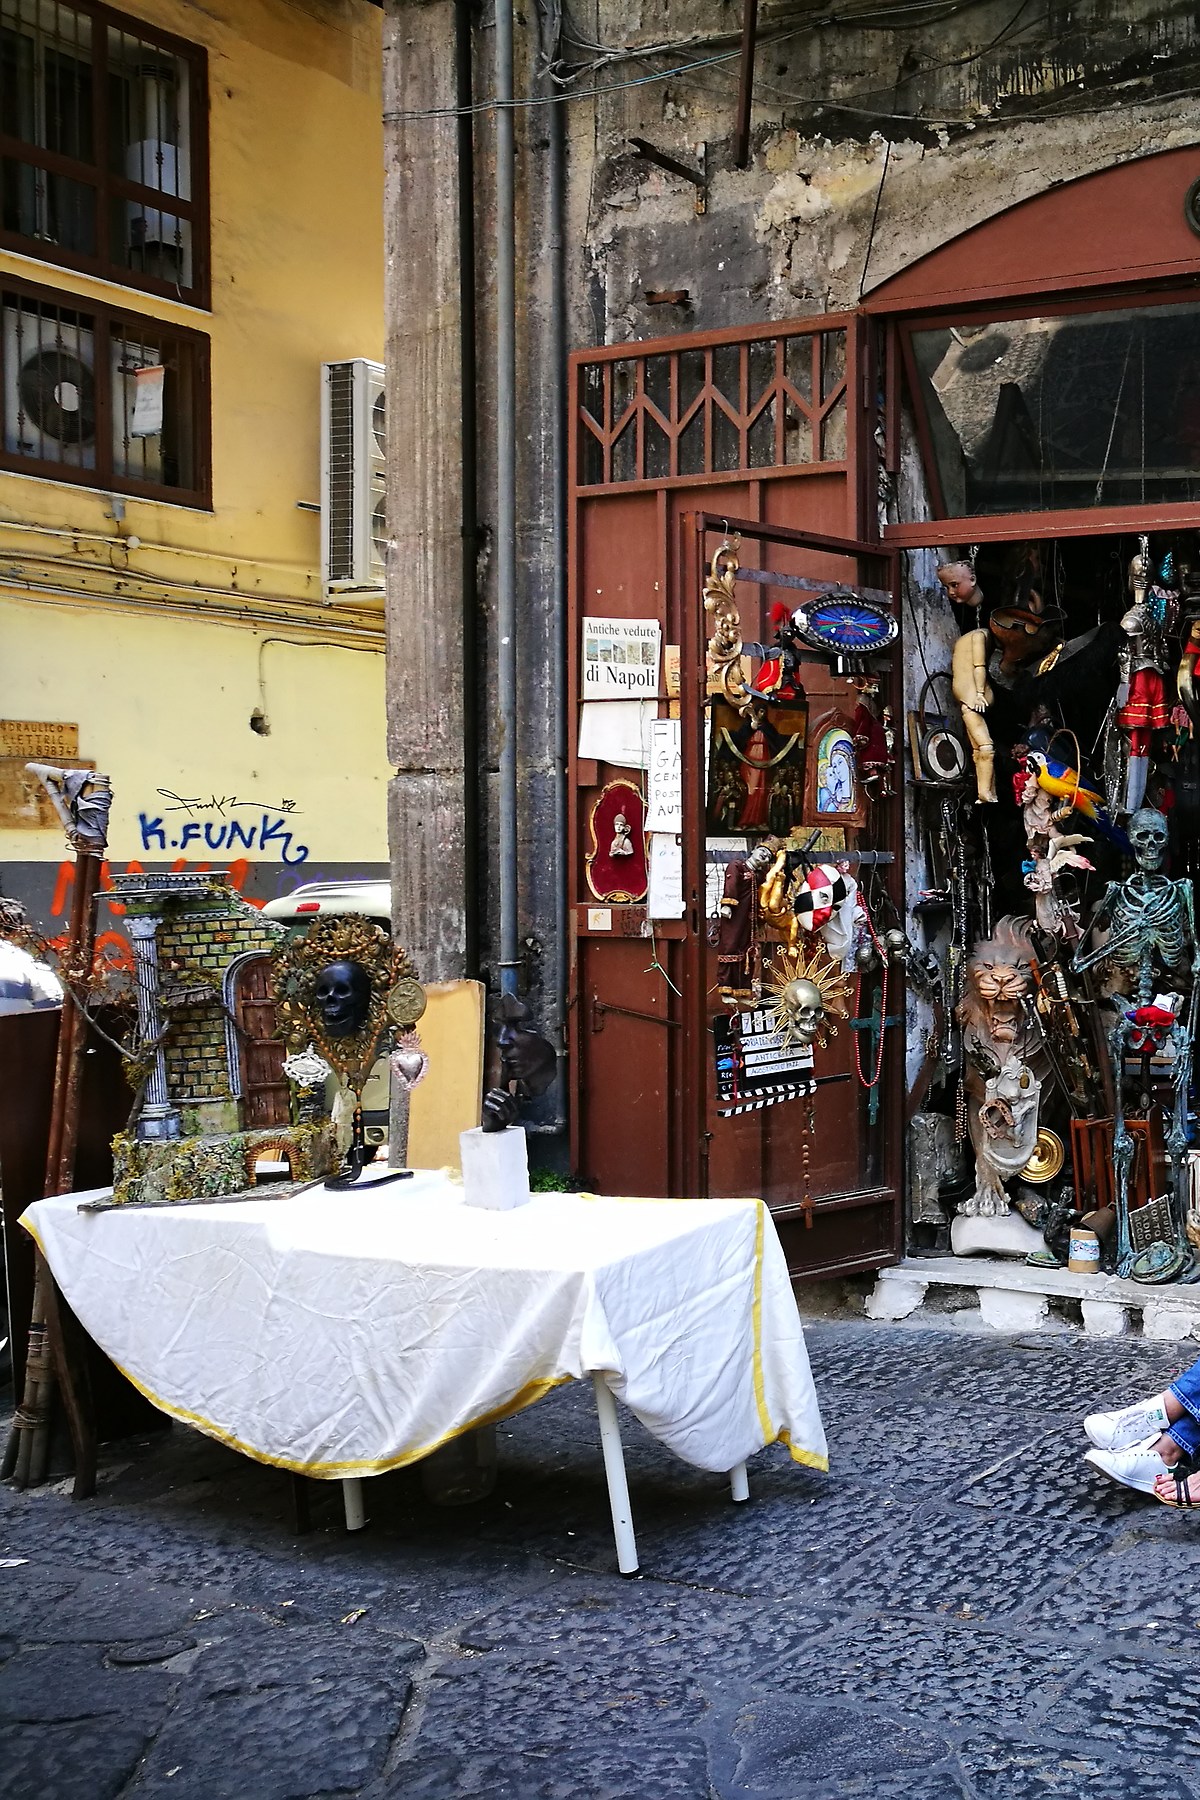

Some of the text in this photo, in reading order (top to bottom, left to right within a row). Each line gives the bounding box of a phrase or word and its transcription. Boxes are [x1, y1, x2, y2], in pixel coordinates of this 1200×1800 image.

[586, 622, 657, 638] Antiche vedute
[586, 664, 600, 682] di
[606, 665, 656, 691] Napoli
[138, 811, 309, 866] K.FUNK
